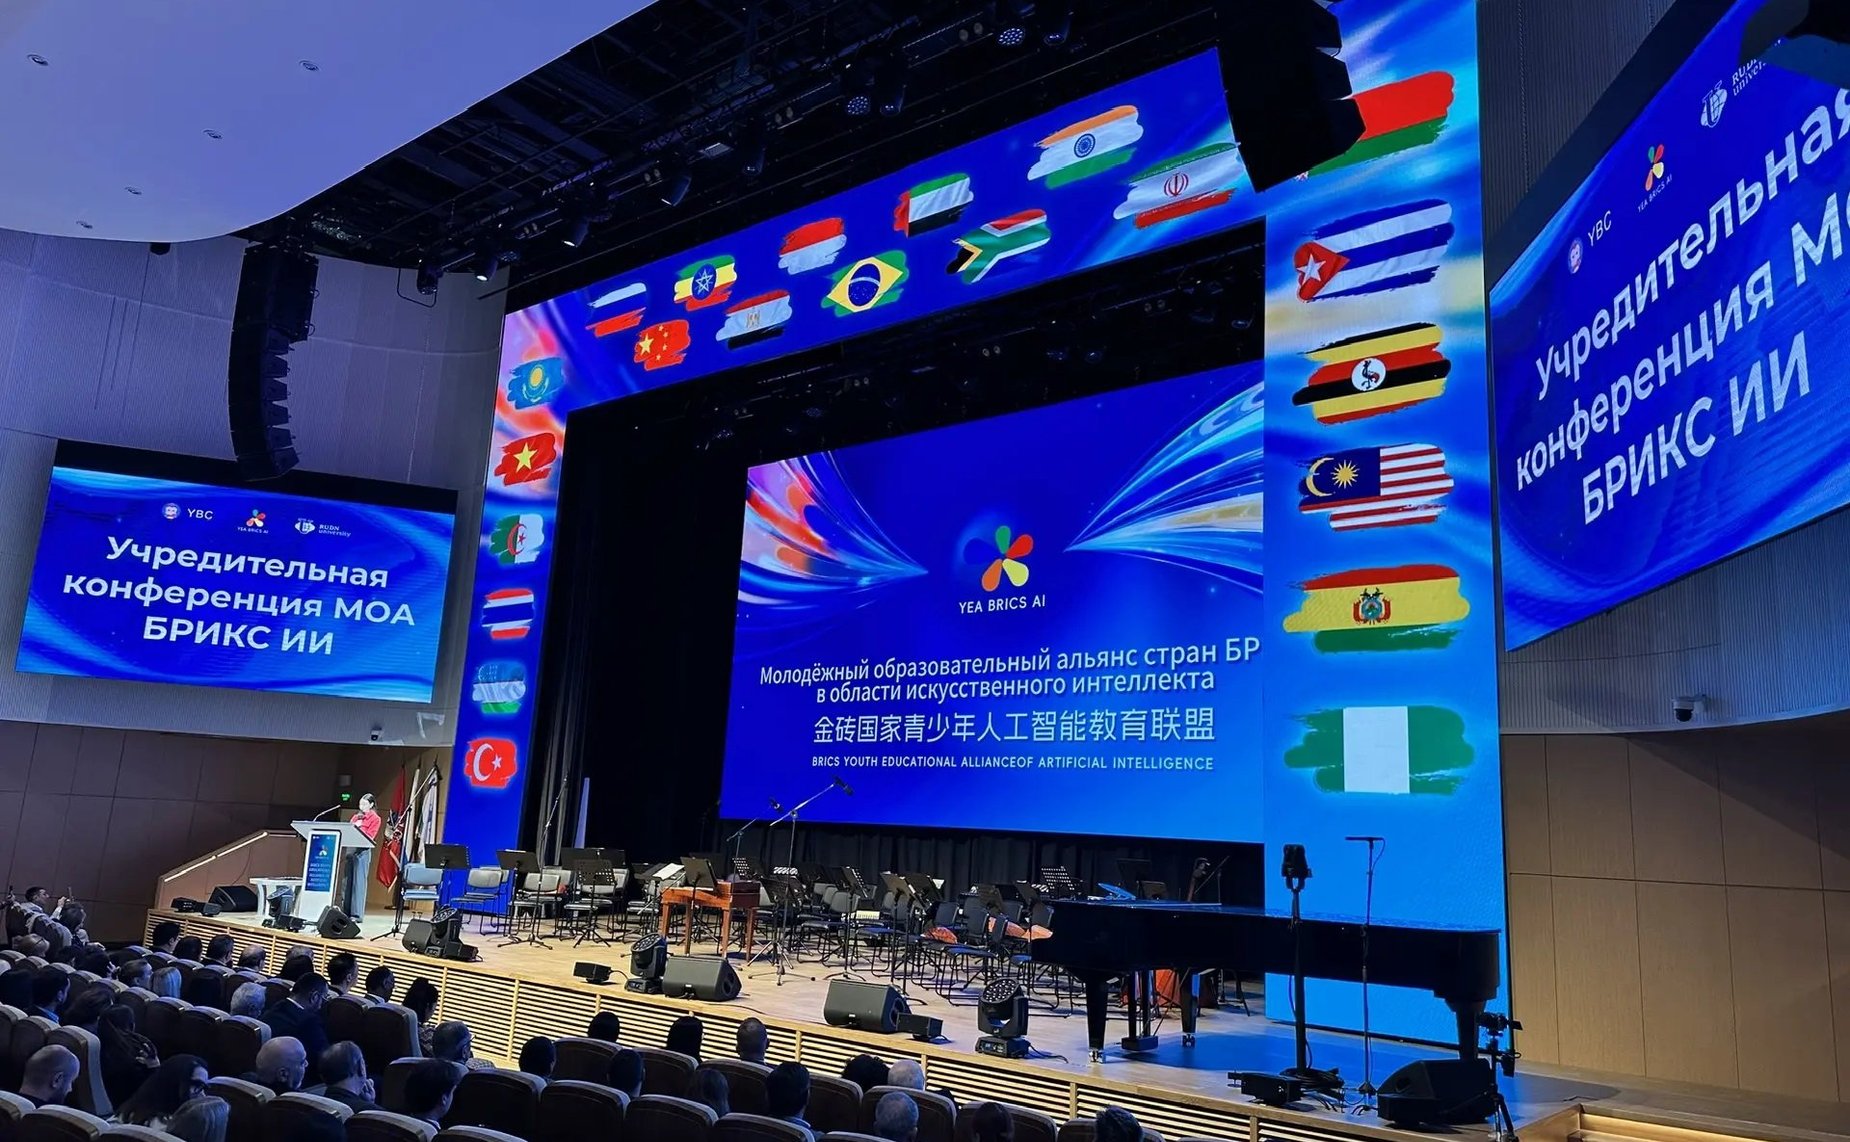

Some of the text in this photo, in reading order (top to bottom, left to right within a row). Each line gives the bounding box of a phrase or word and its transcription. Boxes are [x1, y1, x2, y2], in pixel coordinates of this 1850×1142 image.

[1588, 210, 1612, 247] YBC
[1516, 191, 1850, 491] конференция М
[1582, 330, 1810, 525] БРИКС ИИ
[187, 508, 214, 520] YBC
[106, 536, 388, 588] Учредительная
[63, 574, 415, 626] конференция МОА
[959, 594, 1045, 614] YEA BRICS AI
[143, 615, 334, 655] БРИКС ИИ
[760, 636, 1260, 687] Молодёжный образовательный альянс стран БР
[816, 670, 1214, 705] в области искусственного интеллекта
[813, 707, 1215, 743] 金砖国家青少年人工智能教育联盟
[812, 756, 1214, 770] BRICS YOUTH EDUCATIONAL ALLIANCEOF ARTIFICIAL INTELLIGENCE
